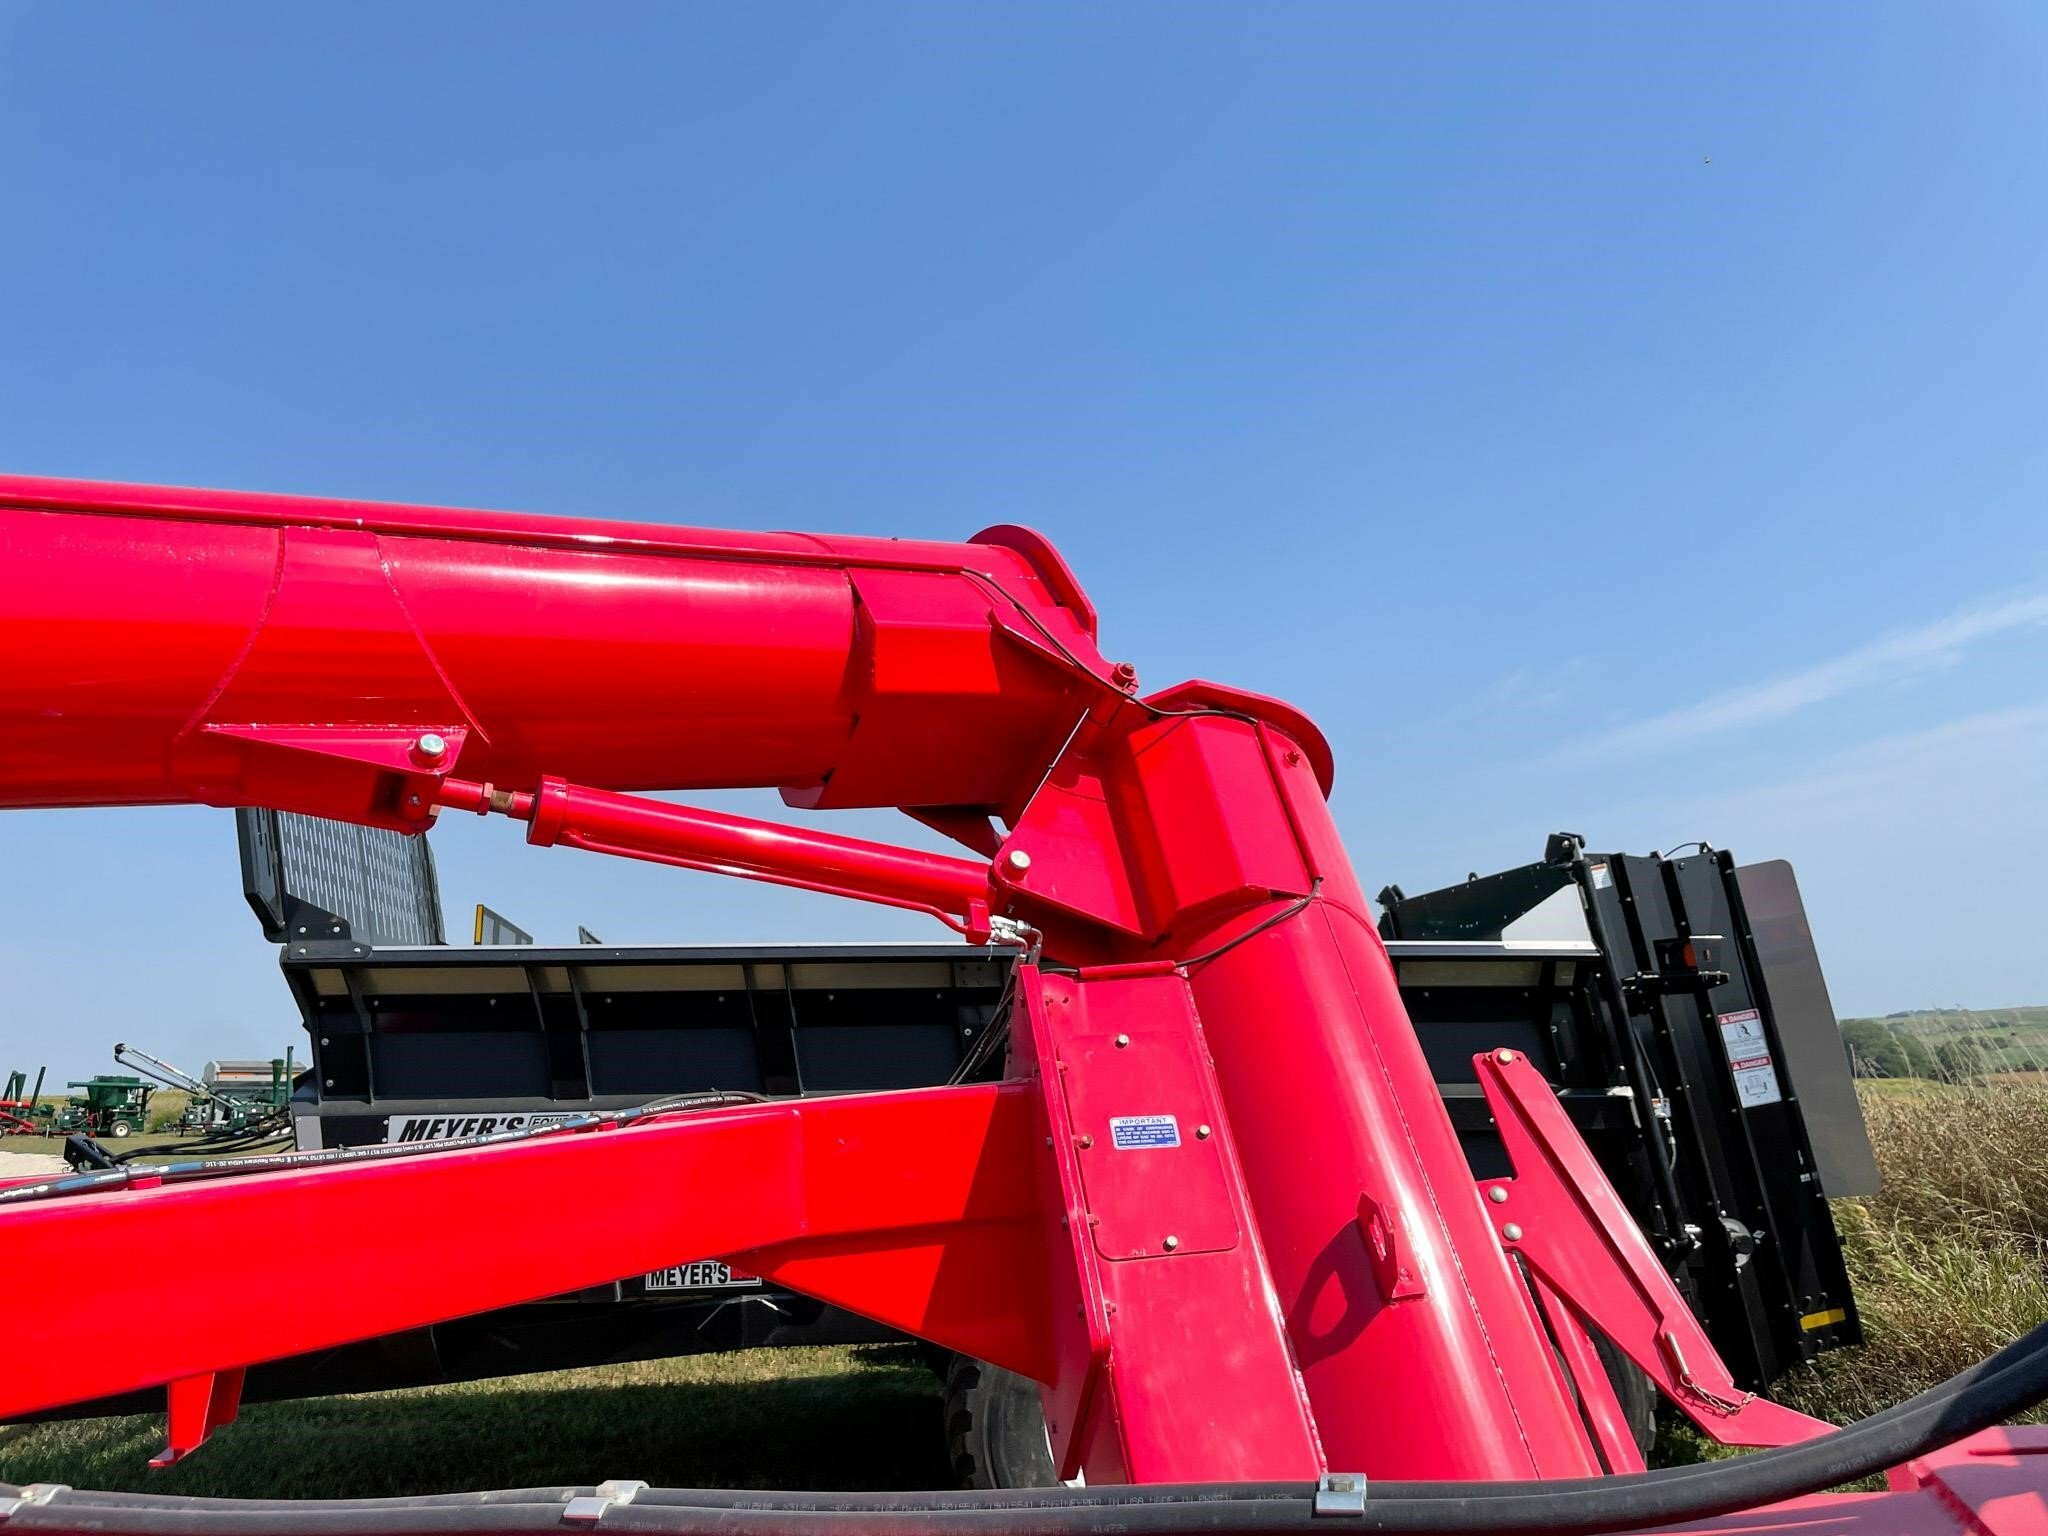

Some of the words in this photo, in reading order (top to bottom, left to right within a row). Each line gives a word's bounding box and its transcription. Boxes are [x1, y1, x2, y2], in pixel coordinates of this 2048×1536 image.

[1728, 1011, 1756, 1023] DANGER
[1740, 1058, 1768, 1069] DANGER
[398, 1116, 525, 1143] MEYER'S
[650, 1263, 729, 1287] MEYER'S
